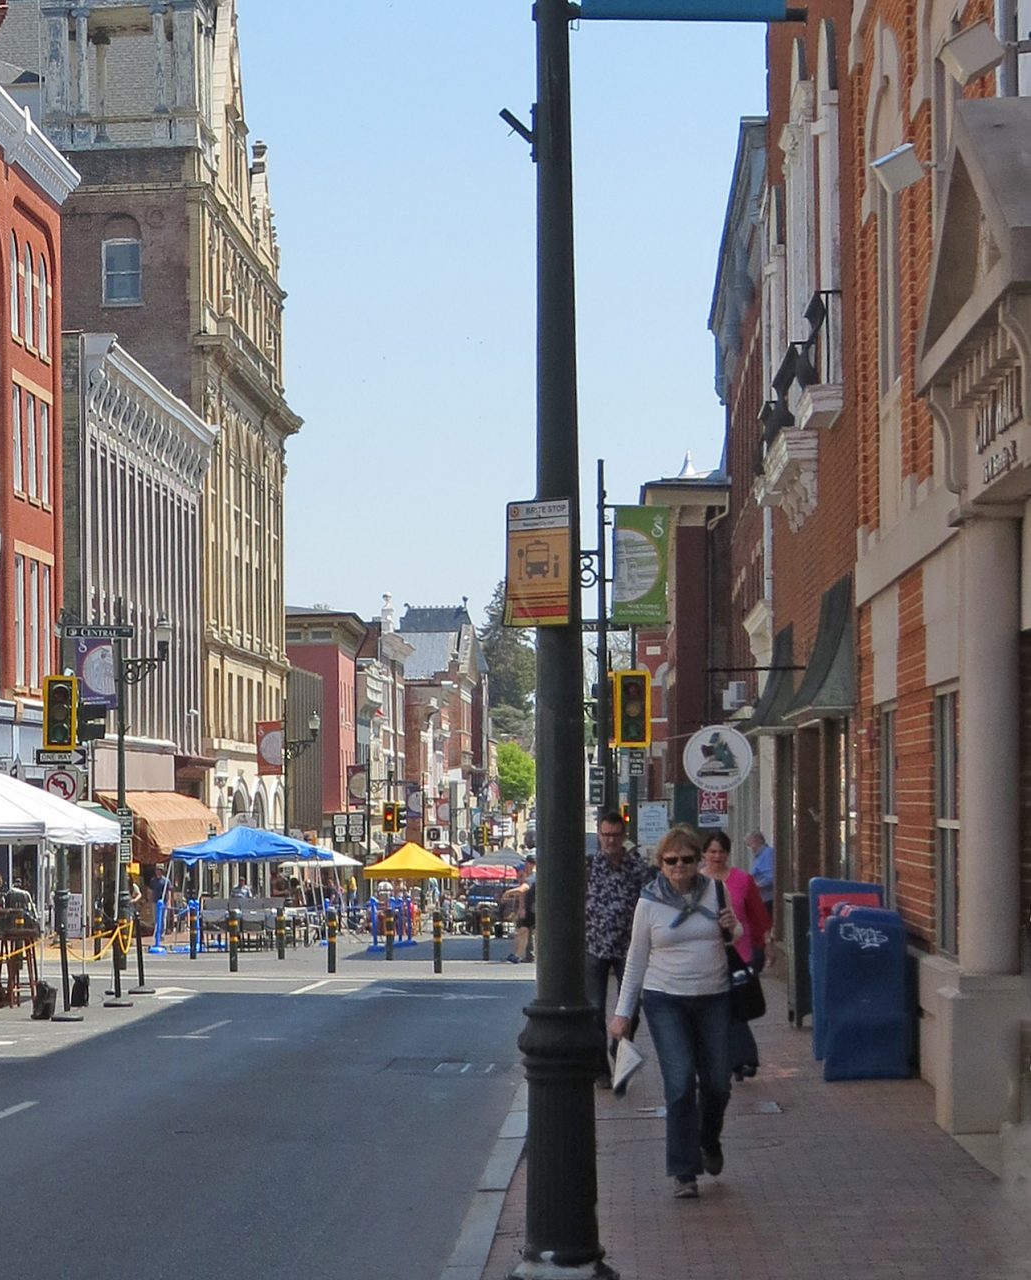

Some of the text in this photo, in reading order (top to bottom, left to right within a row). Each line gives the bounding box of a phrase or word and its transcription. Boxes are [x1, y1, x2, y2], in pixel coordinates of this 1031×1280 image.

[547, 503, 567, 513] STOP
[80, 627, 118, 637] CENTRAL
[41, 753, 72, 761] ONE WAY
[700, 798, 726, 810] ART
